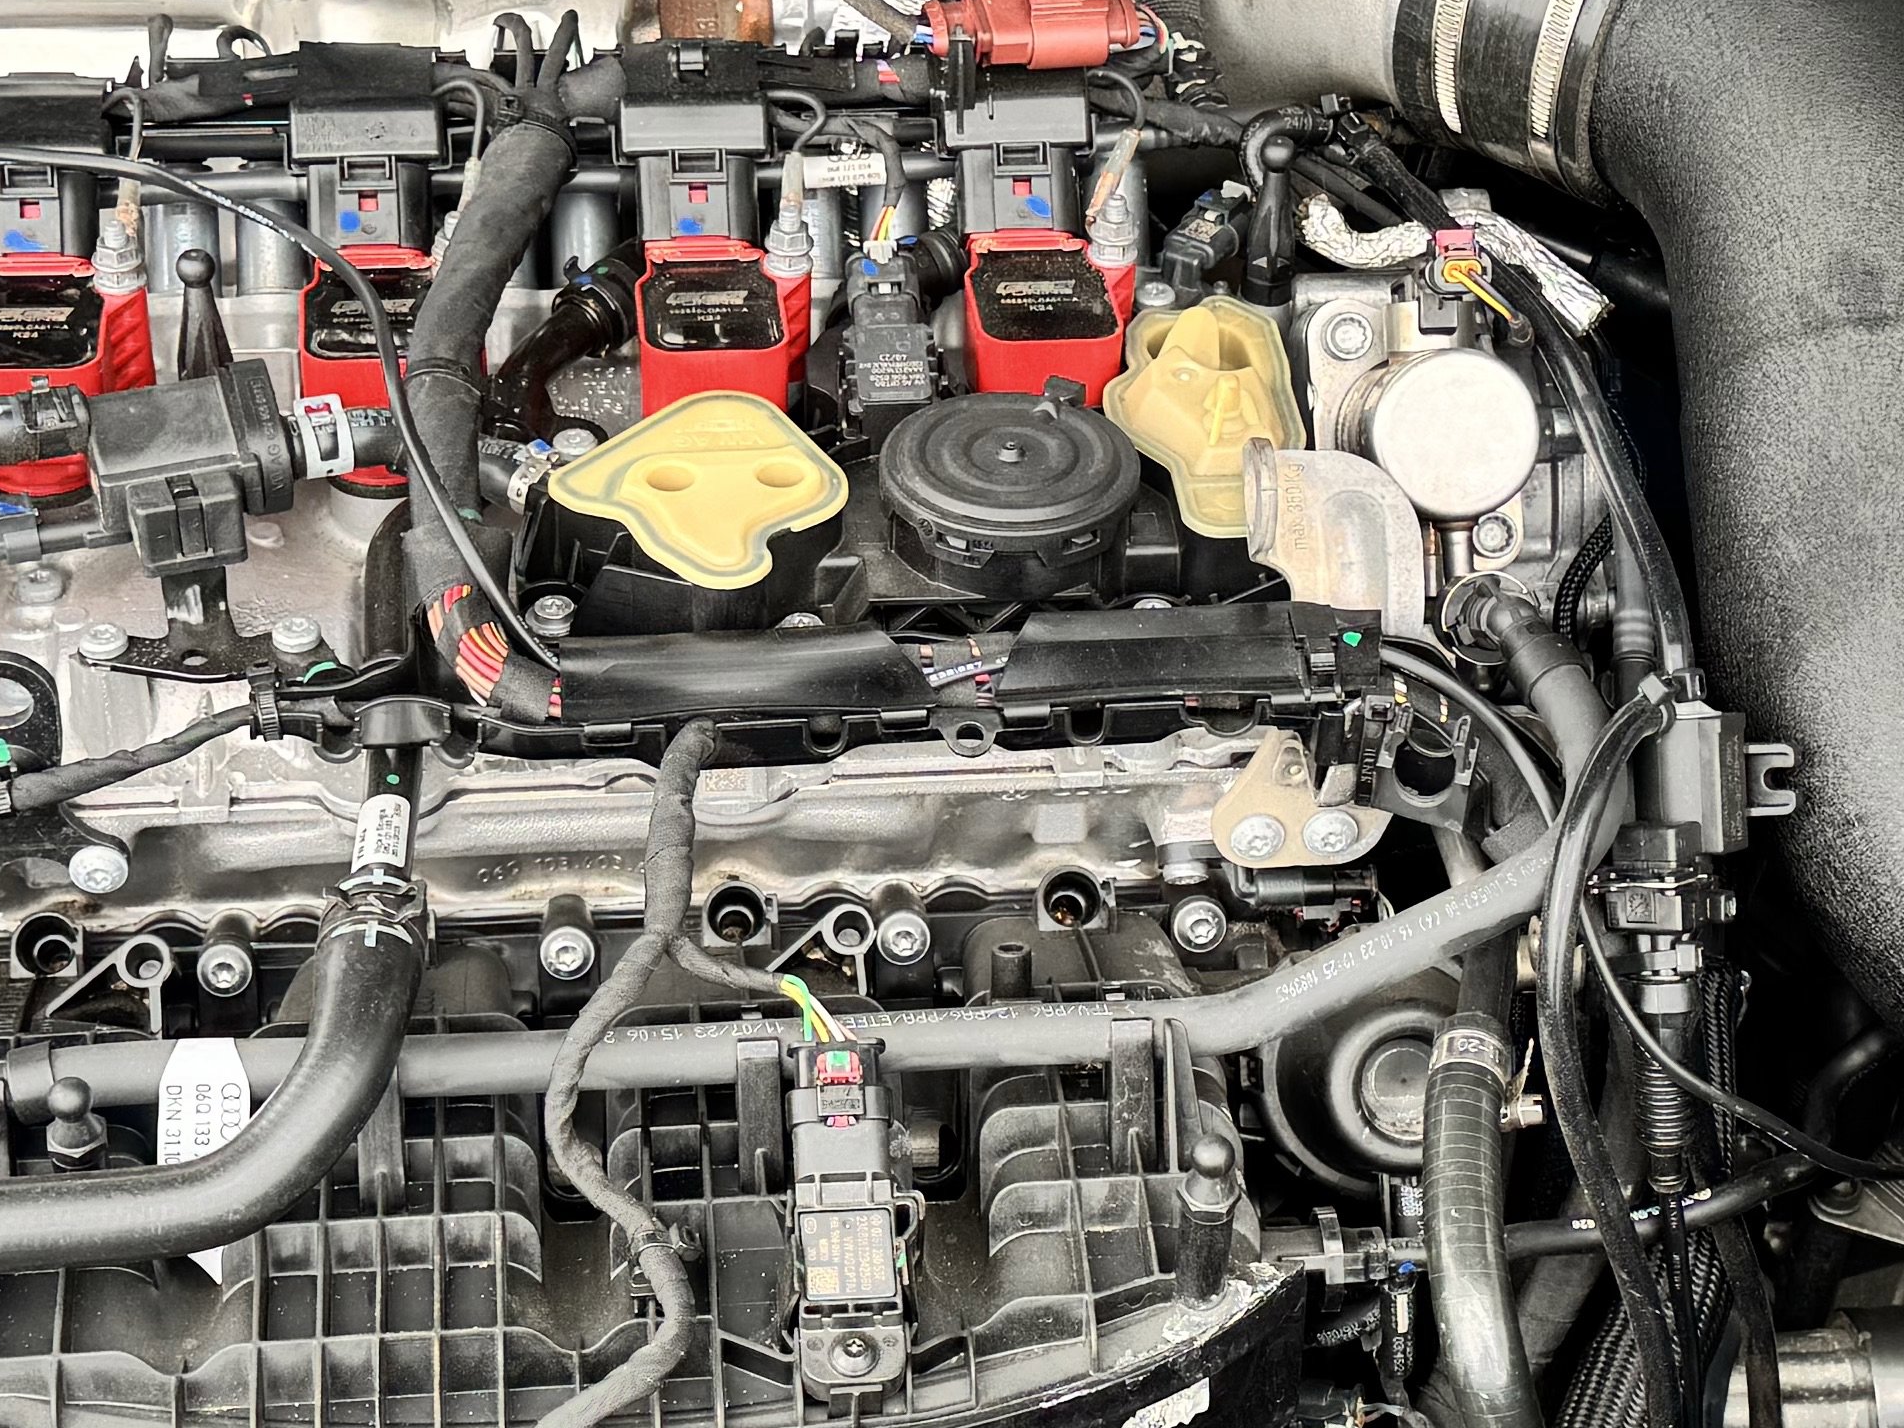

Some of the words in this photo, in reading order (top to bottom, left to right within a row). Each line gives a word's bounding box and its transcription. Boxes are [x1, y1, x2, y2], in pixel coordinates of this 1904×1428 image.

[693, 1021, 784, 1037] 11/07/23
[165, 1084, 182, 1121] DKN
[194, 1082, 211, 1114] 06Q
[193, 1120, 210, 1146] 133
